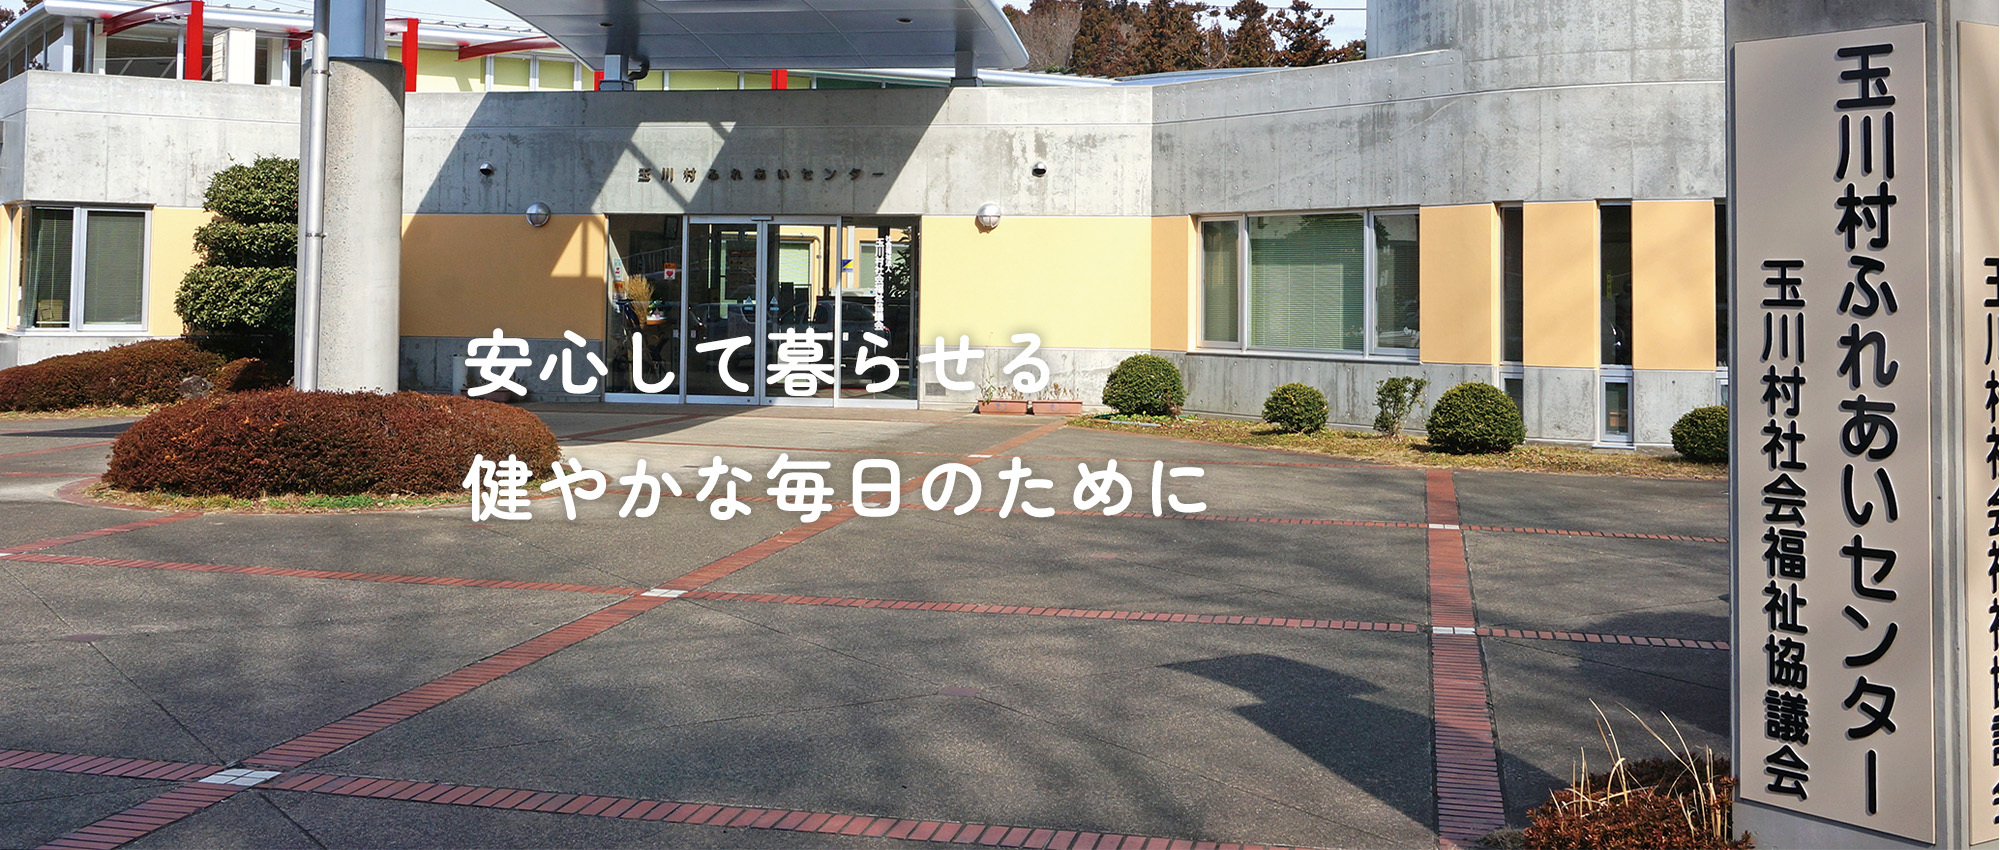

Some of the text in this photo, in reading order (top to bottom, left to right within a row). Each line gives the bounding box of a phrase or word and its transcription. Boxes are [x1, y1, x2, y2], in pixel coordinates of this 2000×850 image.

[637, 167, 884, 183] 玉川村ふれあいセンター
[1836, 43, 1899, 815] 玉川村ふれあいセンター
[1760, 259, 1809, 802] 玉川村社会福祉協議会
